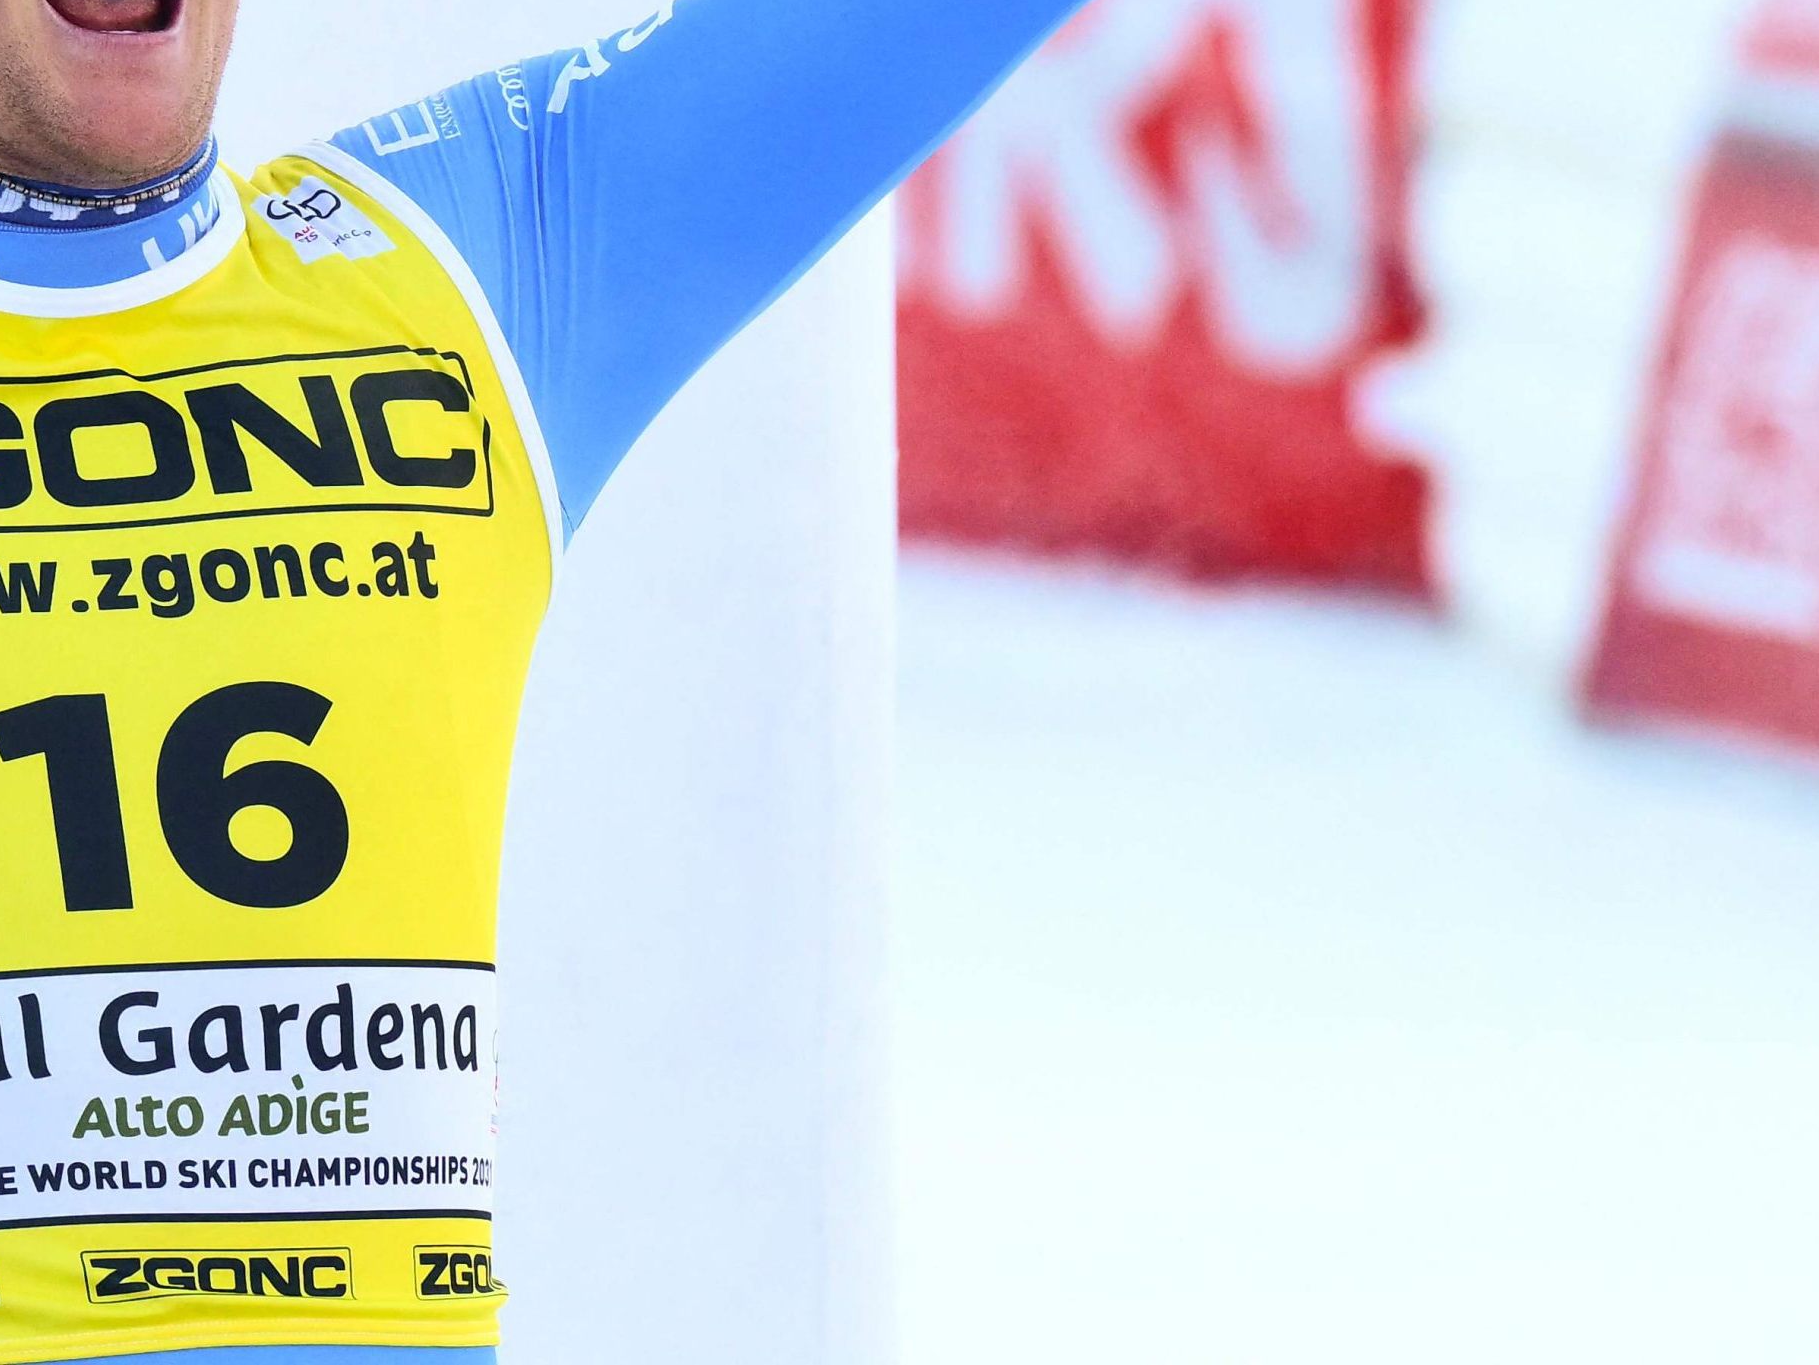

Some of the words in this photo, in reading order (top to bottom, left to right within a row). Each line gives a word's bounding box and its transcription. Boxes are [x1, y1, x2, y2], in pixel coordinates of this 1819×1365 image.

[97, 982, 479, 1077] Gardena
[26, 1160, 168, 1193] WORLD
[178, 1159, 238, 1189] SKI
[248, 1155, 468, 1188] CHAMPIONSHIPS
[89, 1255, 348, 1298] ZGONC
